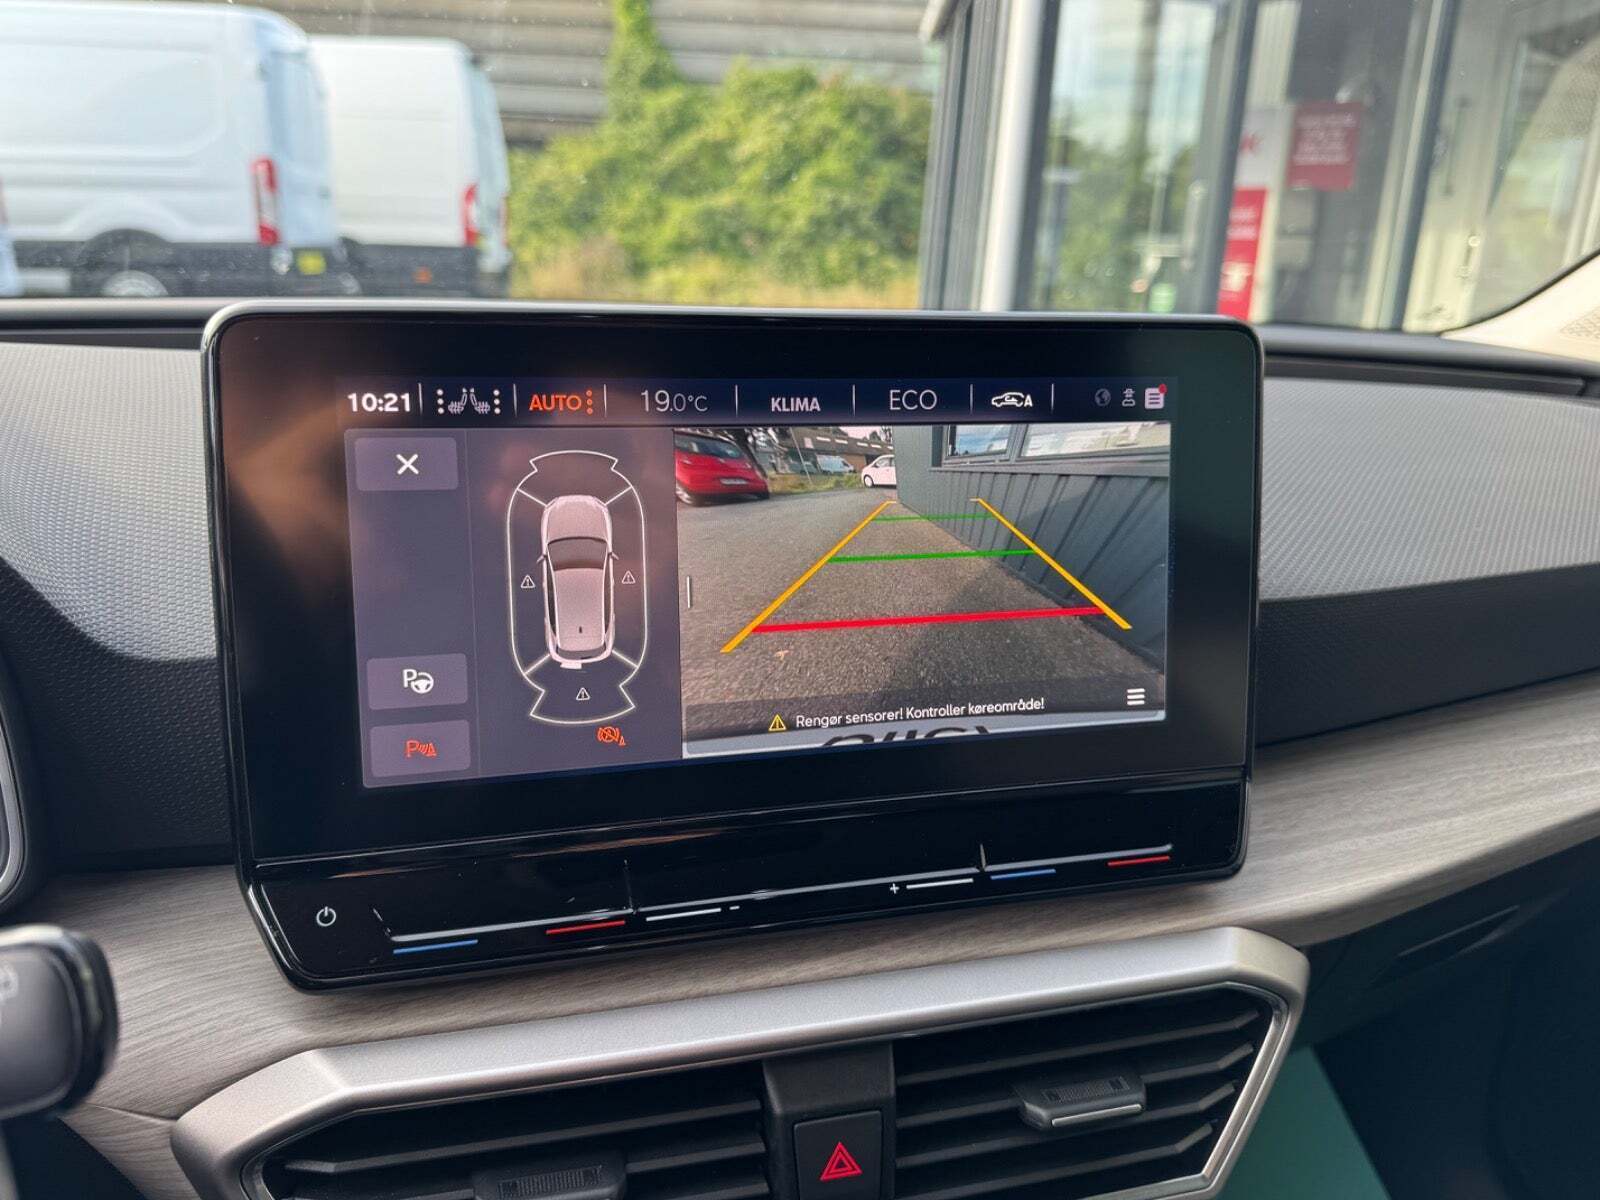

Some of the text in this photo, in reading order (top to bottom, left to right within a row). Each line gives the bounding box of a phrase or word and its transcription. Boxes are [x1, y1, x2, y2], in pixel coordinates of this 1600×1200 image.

[347, 392, 412, 413] 10:21
[529, 394, 582, 412] AUTO
[770, 396, 821, 413] KLIMA
[889, 389, 937, 410] ECO
[795, 697, 1045, 729] Rengør sensorer! Kontroller køreområde!
